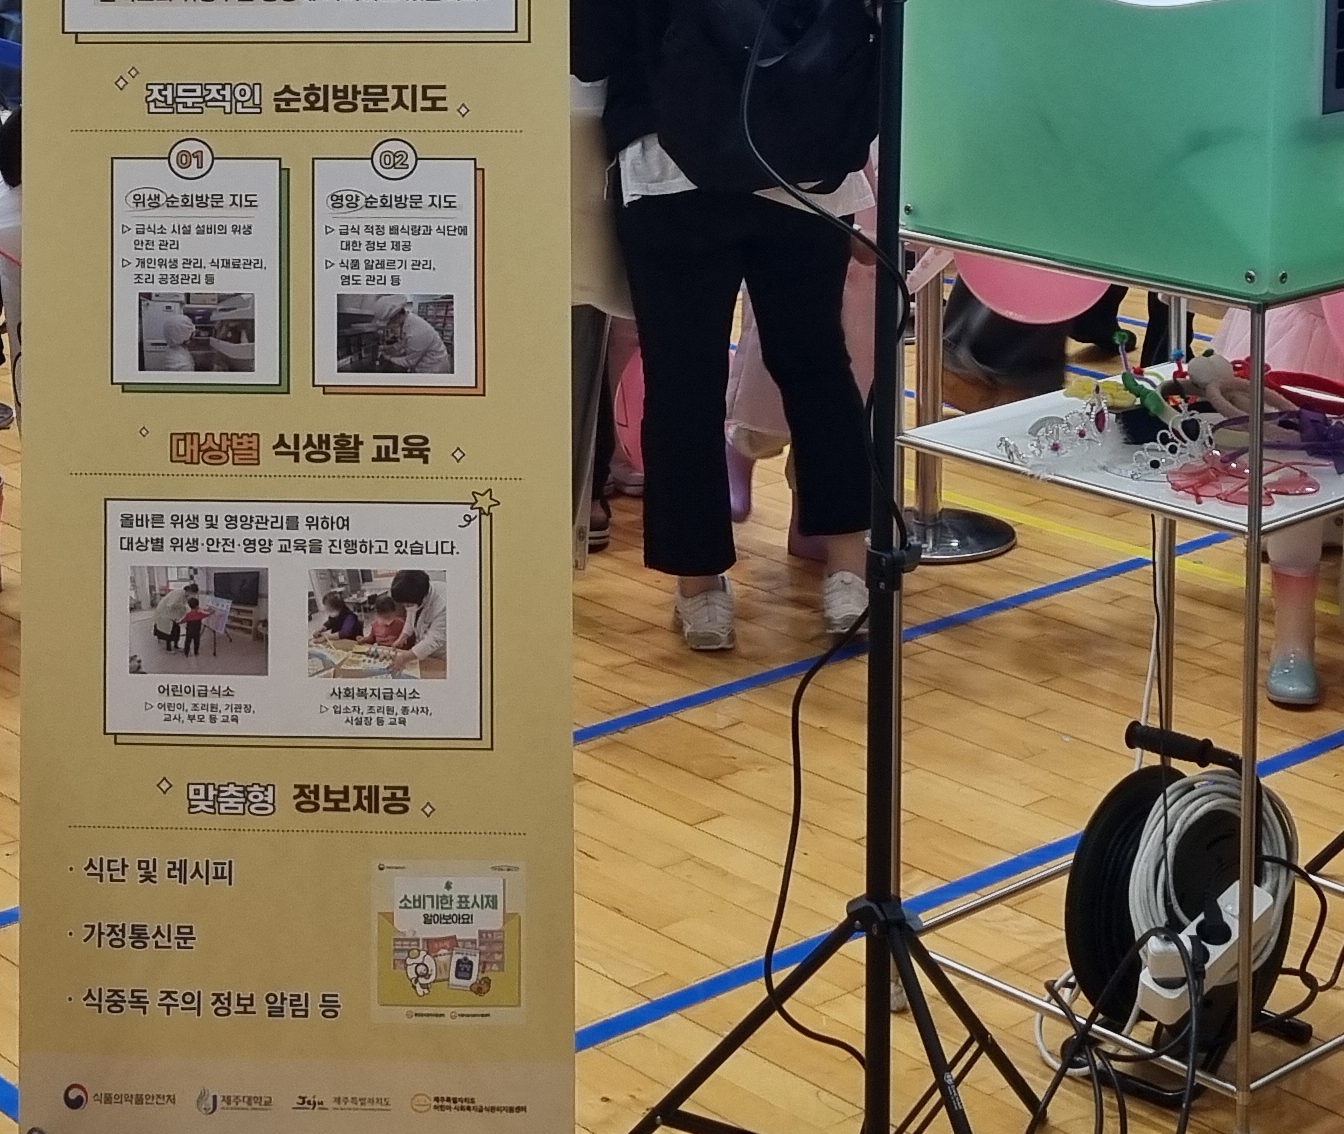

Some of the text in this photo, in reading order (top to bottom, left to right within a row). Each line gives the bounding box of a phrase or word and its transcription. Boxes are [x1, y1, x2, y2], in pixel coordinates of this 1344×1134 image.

[145, 82, 448, 115] 전문적인 순회방문지도
[176, 149, 204, 169] 01
[379, 150, 409, 170] 02
[132, 193, 259, 209] 위생 순회방문 지도
[330, 194, 457, 209] 영양 순회방문 지도
[135, 223, 253, 236] 급식소 시설 설비의 위생
[338, 224, 360, 236] 급식
[364, 224, 385, 236] 적정
[436, 224, 468, 236] 식단에
[133, 239, 179, 251] 안전 관리
[340, 240, 412, 252] 대한 정보 제공
[135, 257, 179, 270] 개인위생
[339, 259, 360, 271] 식품
[364, 259, 407, 271] 알레르기
[134, 273, 155, 285] 조리
[158, 273, 201, 285] 공정관리
[365, 274, 387, 286] 관리
[169, 432, 431, 466] 대상별 식생활 교육
[120, 513, 350, 530] 올바른 위생 및 영양관리를 위하여
[120, 537, 460, 554] 대상별 위생·안전·영양 교육을 진행하고 있습니다.
[157, 684, 235, 697] 어린이급식소
[330, 687, 421, 700] 사회복지급식소
[187, 714, 205, 724] 부모
[186, 782, 411, 816] 맞춤형 정보제공
[83, 856, 234, 886] 식단 및 레시피
[398, 894, 498, 910] 소비기한 표시제
[82, 922, 197, 951] 가정통신문
[81, 987, 341, 1019] 식중독 주의 정보 알림 등
[296, 1095, 324, 1109] Jeju
